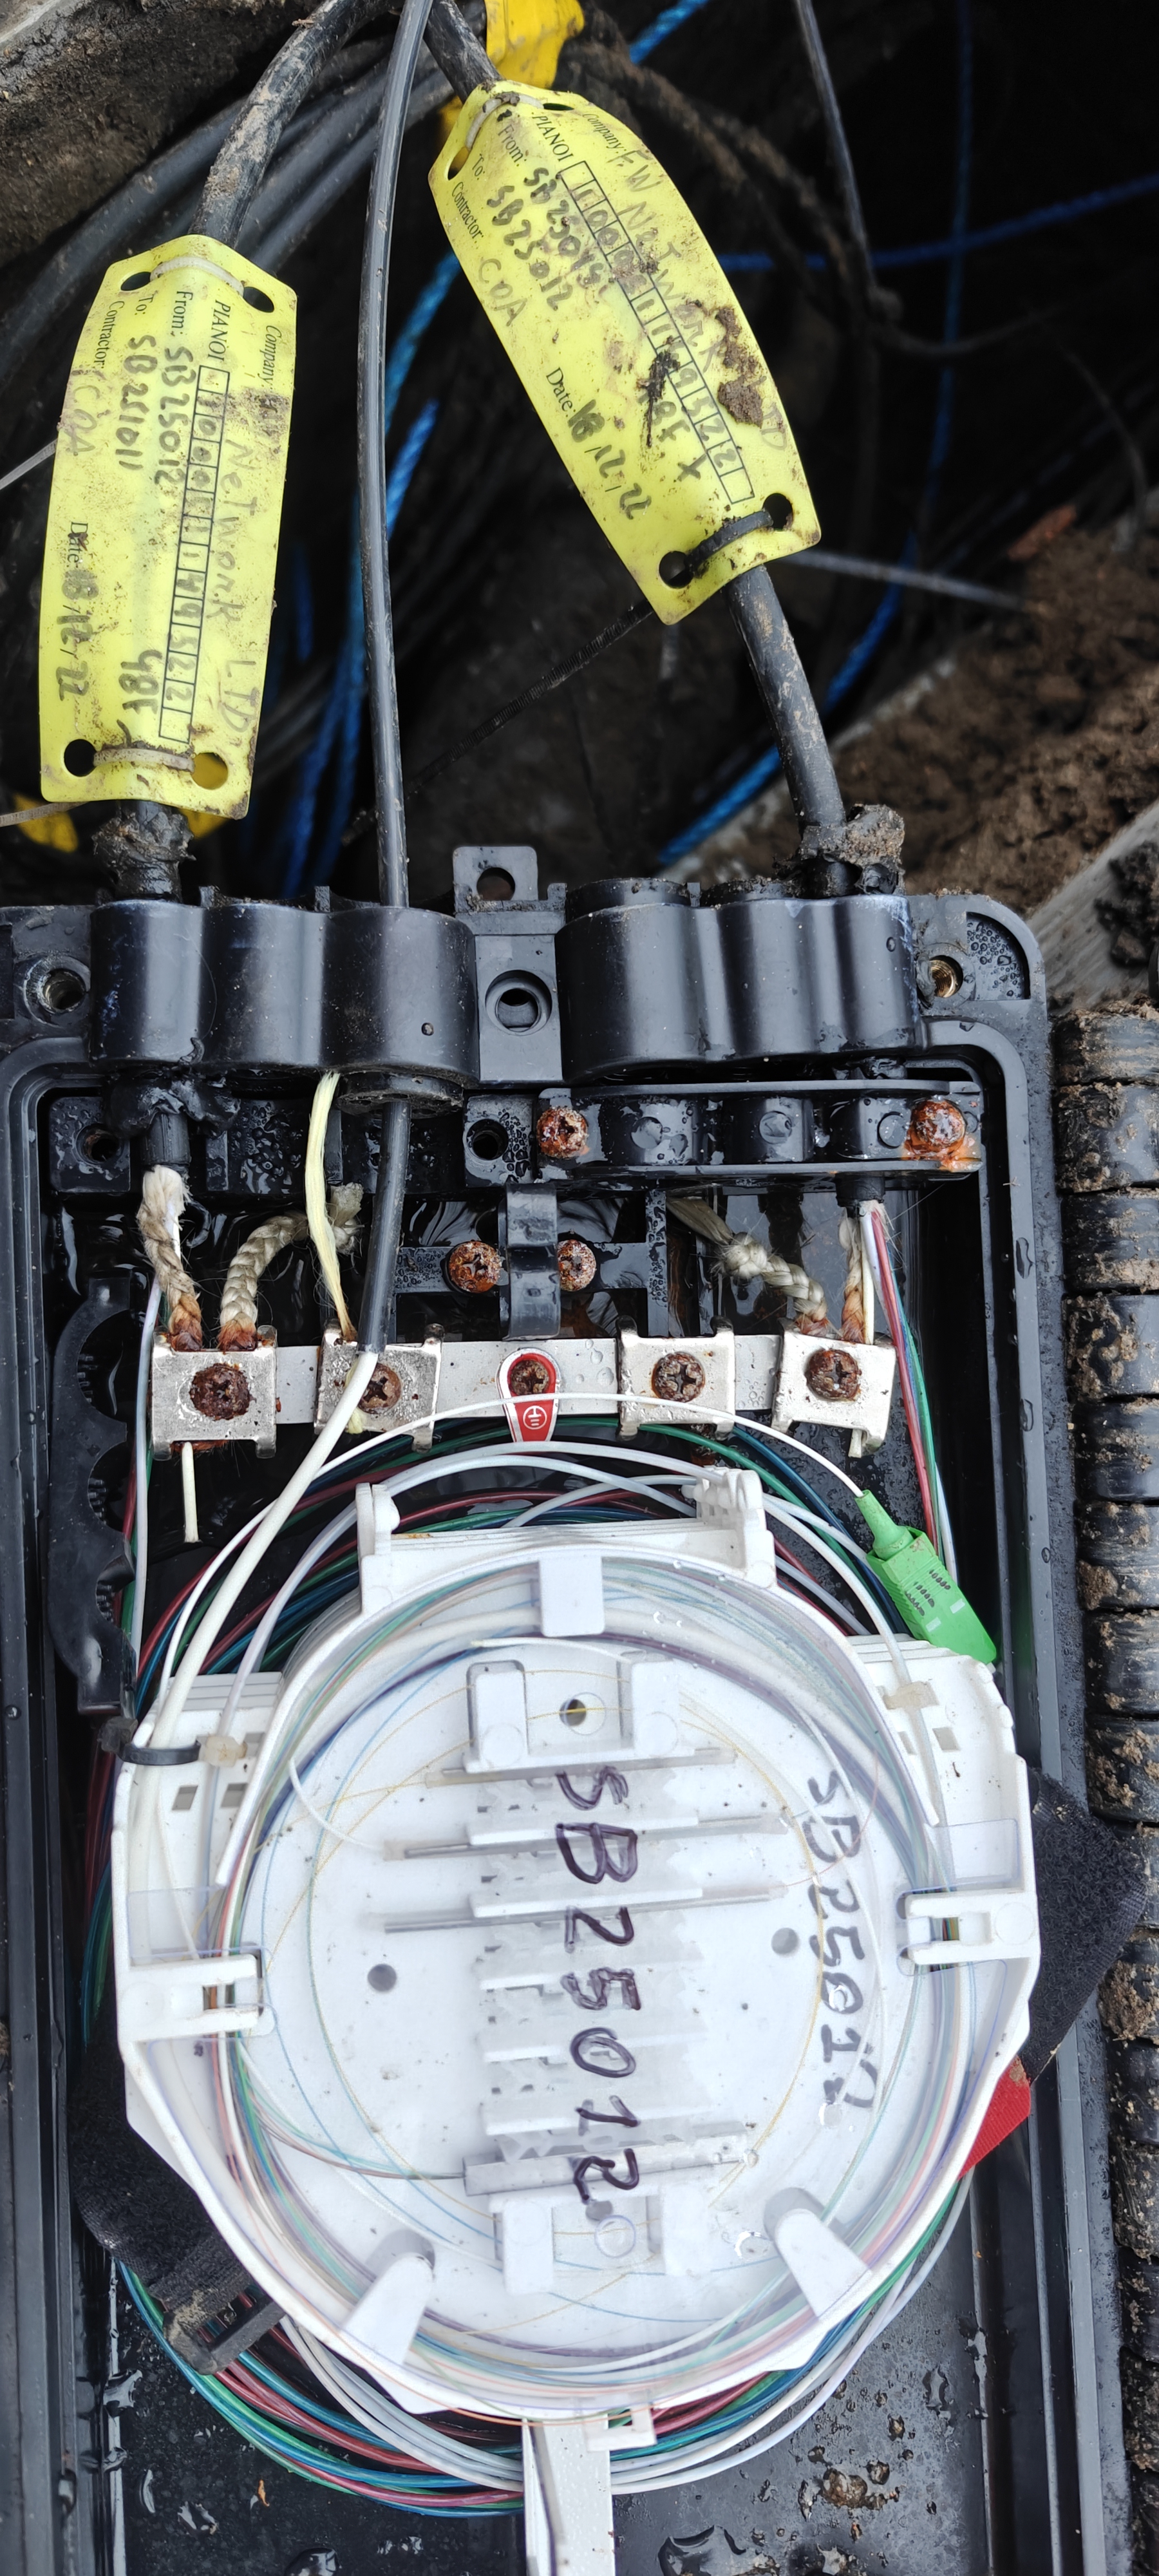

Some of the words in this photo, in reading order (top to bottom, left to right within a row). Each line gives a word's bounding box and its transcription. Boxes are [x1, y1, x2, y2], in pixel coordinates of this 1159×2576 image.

[498, 125, 527, 167] From:
[582, 113, 627, 154] Company:
[471, 154, 485, 180] To:
[451, 182, 484, 243] Contractor:
[135, 294, 155, 315] To:
[171, 291, 193, 336] From:
[94, 301, 124, 369] Contractor:
[258, 325, 282, 390] Company:
[546, 367, 576, 418] Date:
[67, 522, 88, 567] Date:
[554, 1766, 640, 2204] SB25012
